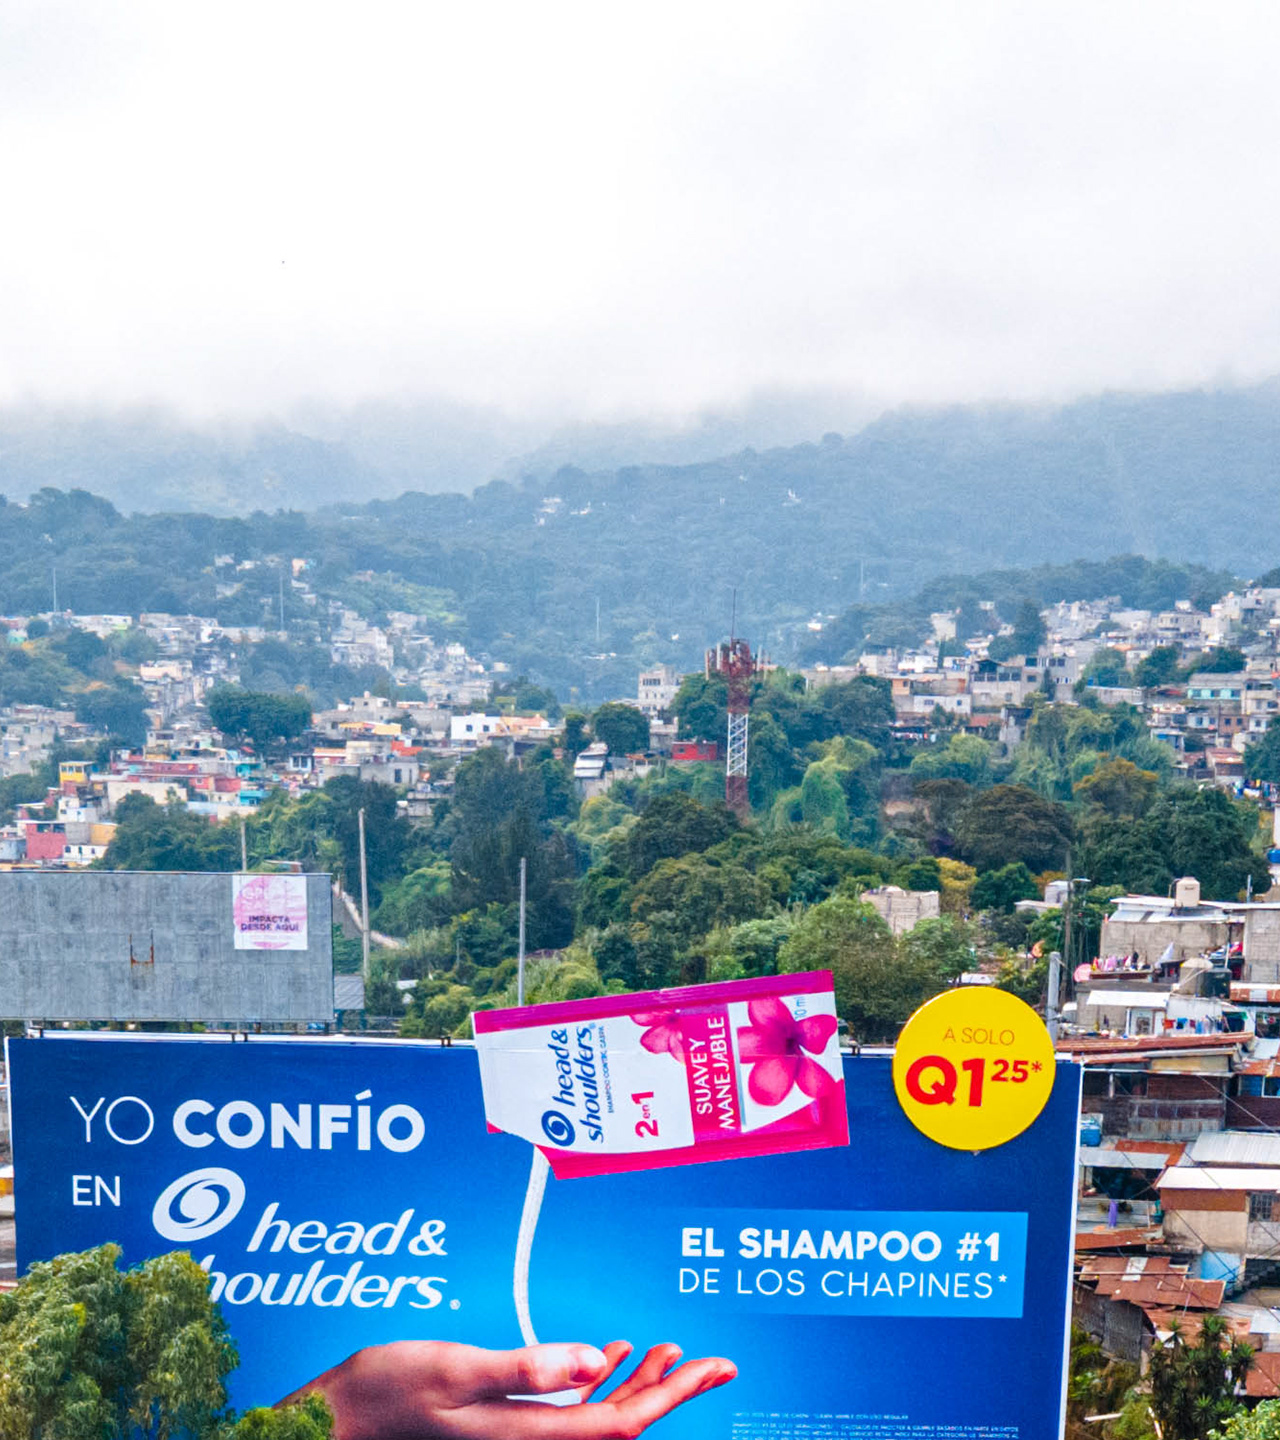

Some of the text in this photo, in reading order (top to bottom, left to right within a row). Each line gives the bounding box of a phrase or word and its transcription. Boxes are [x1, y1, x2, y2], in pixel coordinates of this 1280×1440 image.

[943, 1027, 1015, 1046] A SOLO
[707, 1016, 736, 1130] MANEJABLE
[70, 1089, 426, 1153] YO CONFÍO
[72, 1175, 121, 1206] EN
[681, 1227, 1000, 1262] EL SHAMPOO #1
[679, 1268, 721, 1294] DE
[737, 1269, 805, 1296] LOS
